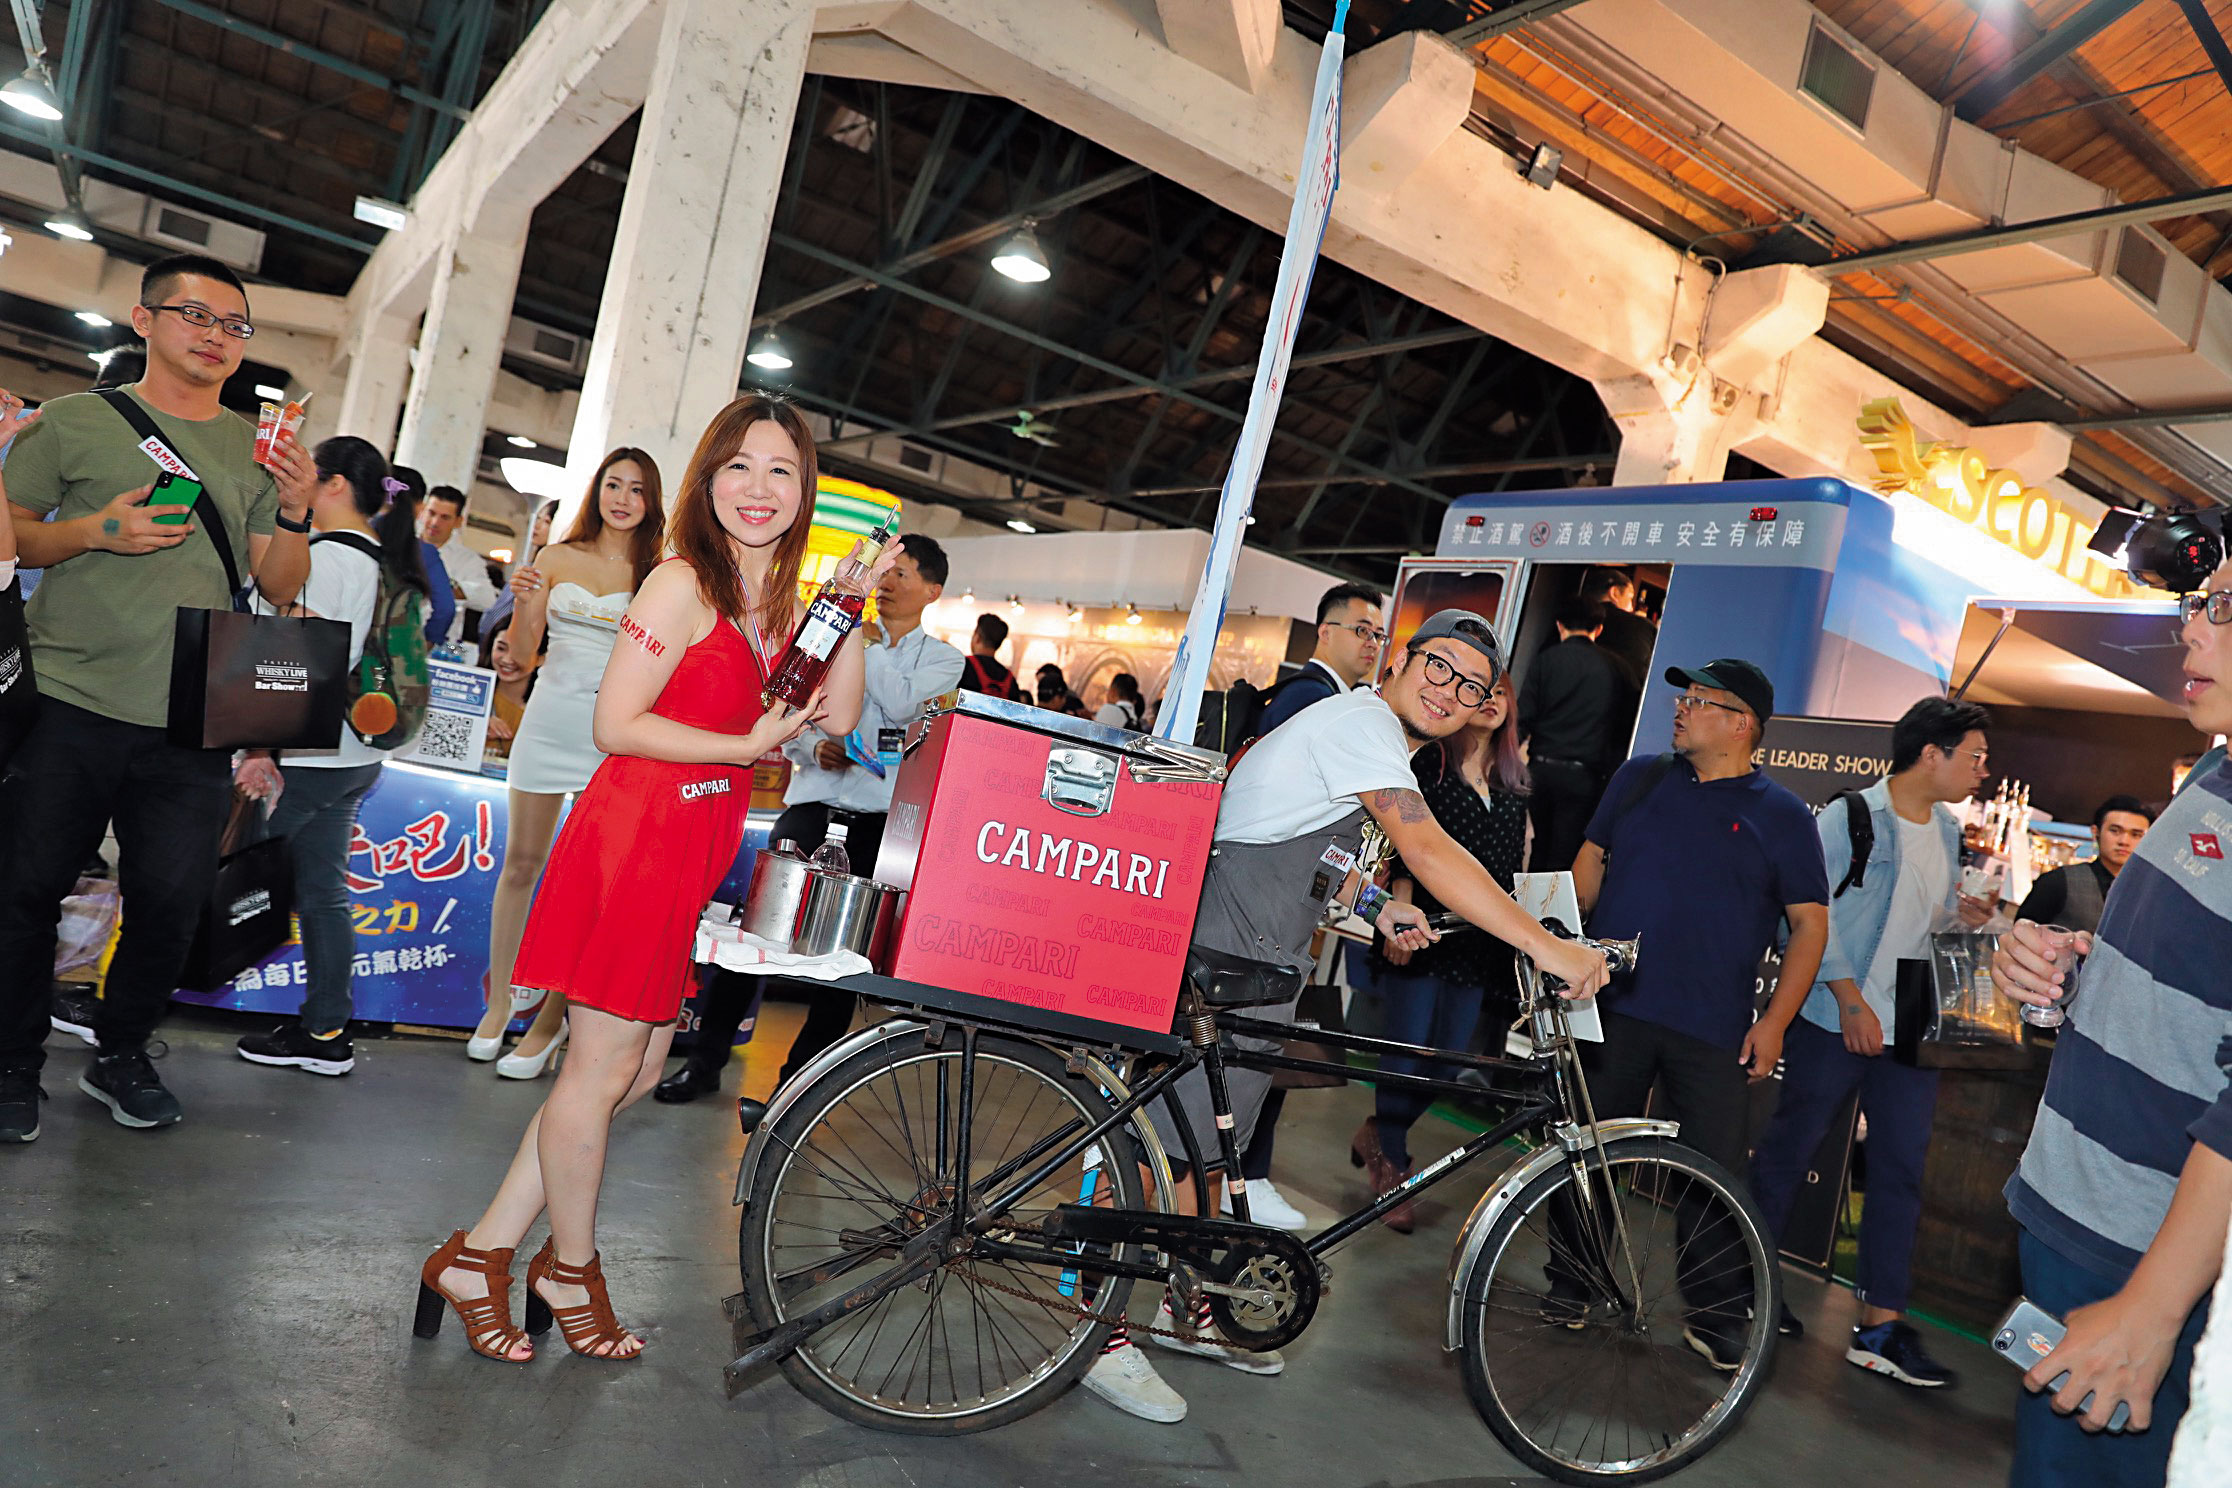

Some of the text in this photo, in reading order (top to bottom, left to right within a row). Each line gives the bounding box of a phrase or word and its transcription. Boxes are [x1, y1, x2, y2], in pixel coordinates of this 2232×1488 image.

[1451, 519, 1805, 547] 禁止酒駕 酒後不開車 安全有保障
[811, 602, 852, 633] CAMPARI
[620, 613, 665, 657] CAMPARI
[255, 681, 295, 691] Bar Show
[256, 667, 308, 677] WHISKY LIVE
[435, 669, 476, 684] facebook
[1770, 749, 1829, 772] LEADER
[1834, 754, 1894, 777] SHOW
[682, 778, 731, 800] CAMPARI
[976, 820, 1170, 899] CAMPARI
[1177, 815, 1205, 886] CAMPARI
[966, 883, 1050, 918] CAMPARI
[1131, 902, 1190, 927] CAMPARI
[914, 914, 1081, 979] CAMPARI
[1077, 913, 1182, 956] CAMPARI
[981, 978, 1067, 1012] CAMPARI
[1086, 983, 1168, 1017] CAMPARI
